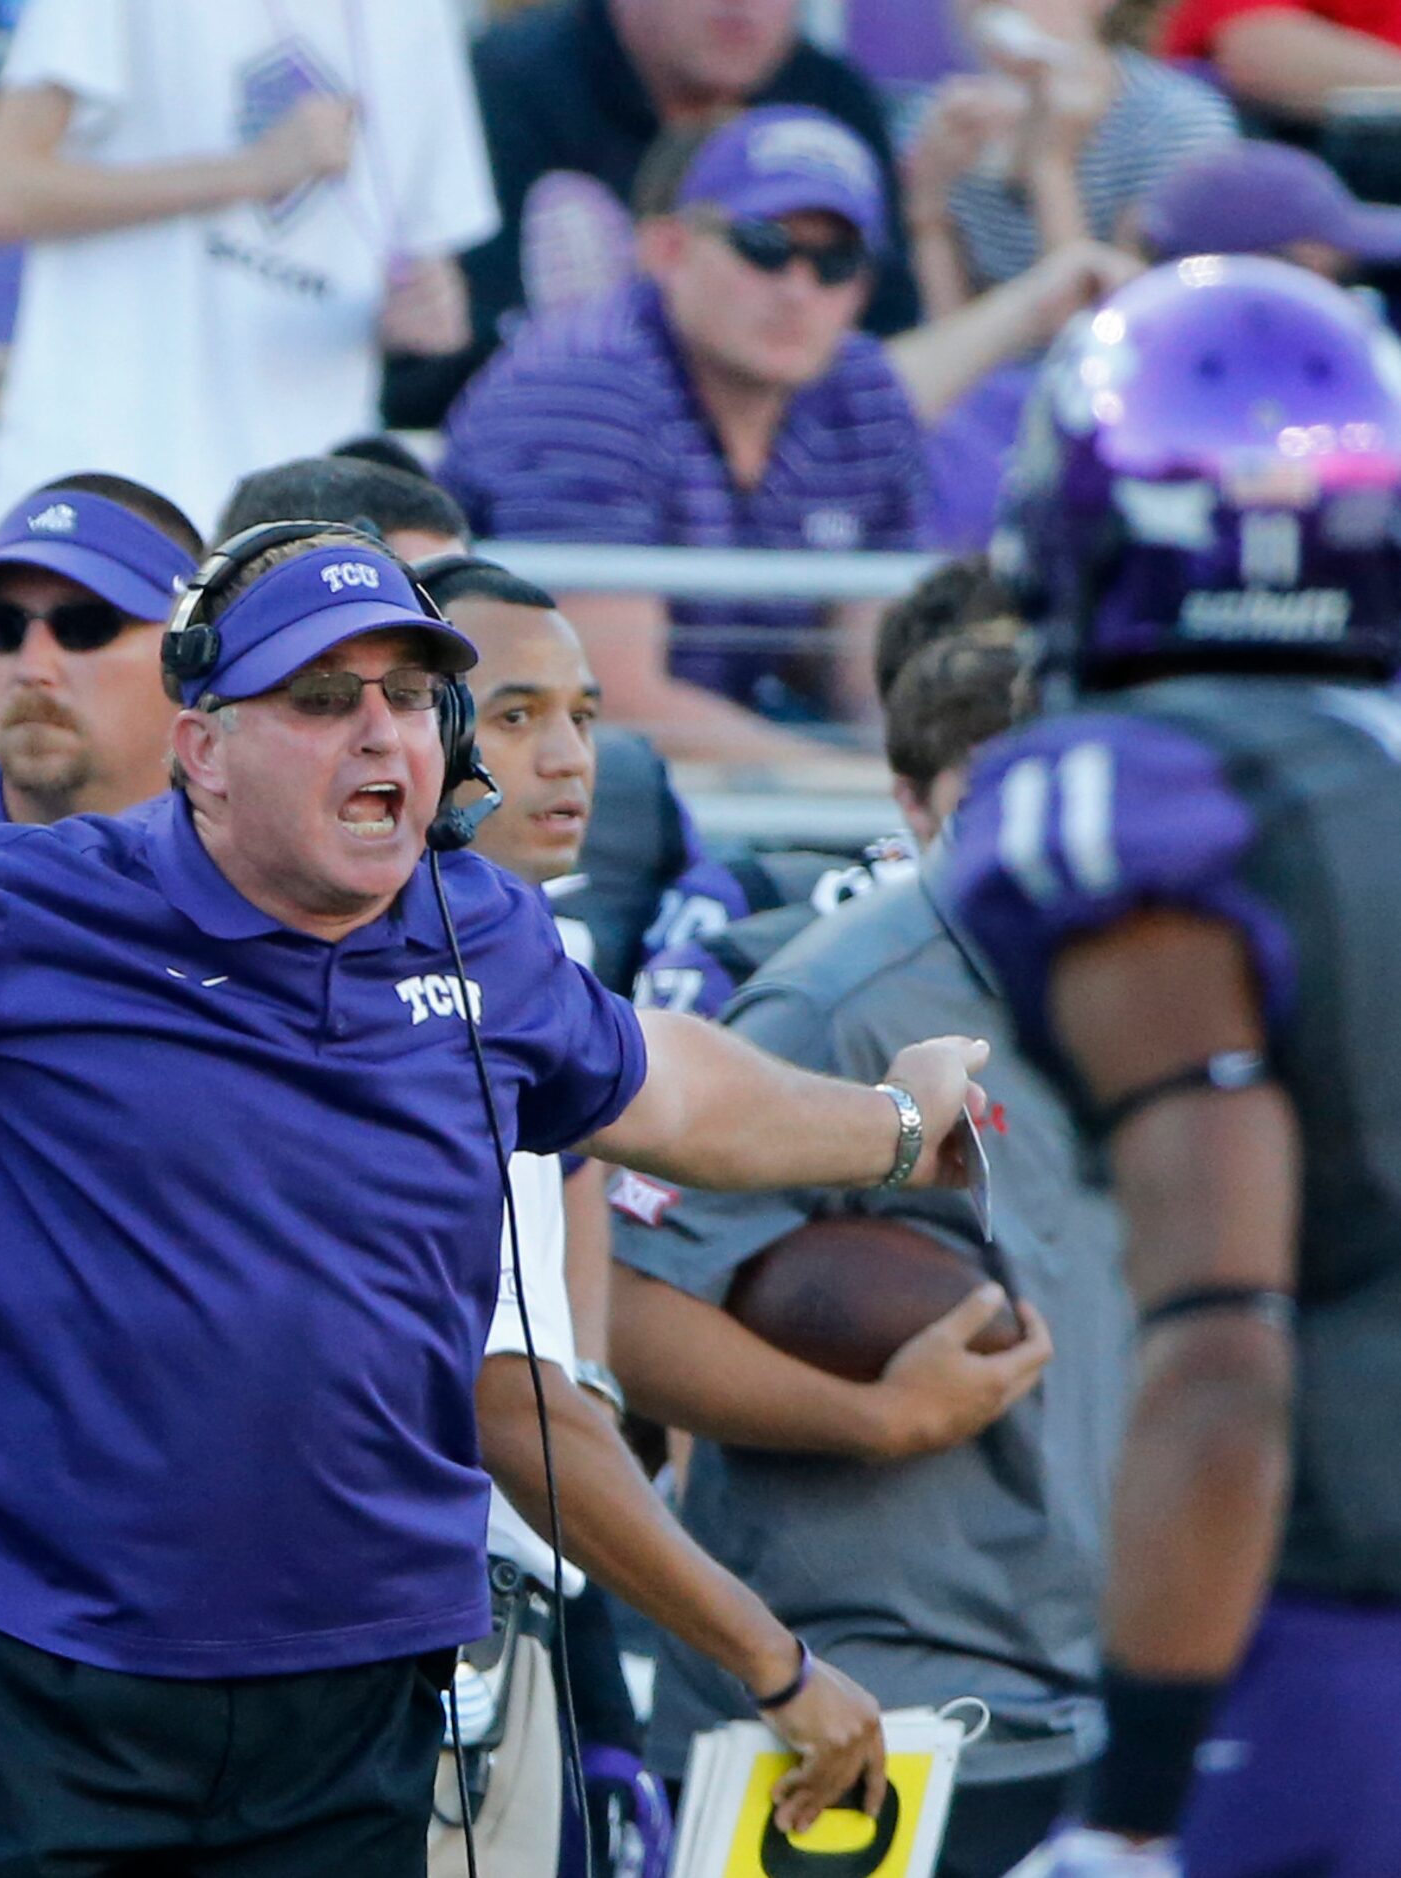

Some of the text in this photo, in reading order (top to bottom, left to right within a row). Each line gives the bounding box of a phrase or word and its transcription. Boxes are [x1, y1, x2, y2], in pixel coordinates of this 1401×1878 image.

[320, 562, 380, 593] TCU
[999, 741, 1117, 904] 11
[394, 973, 482, 1026] TCU
